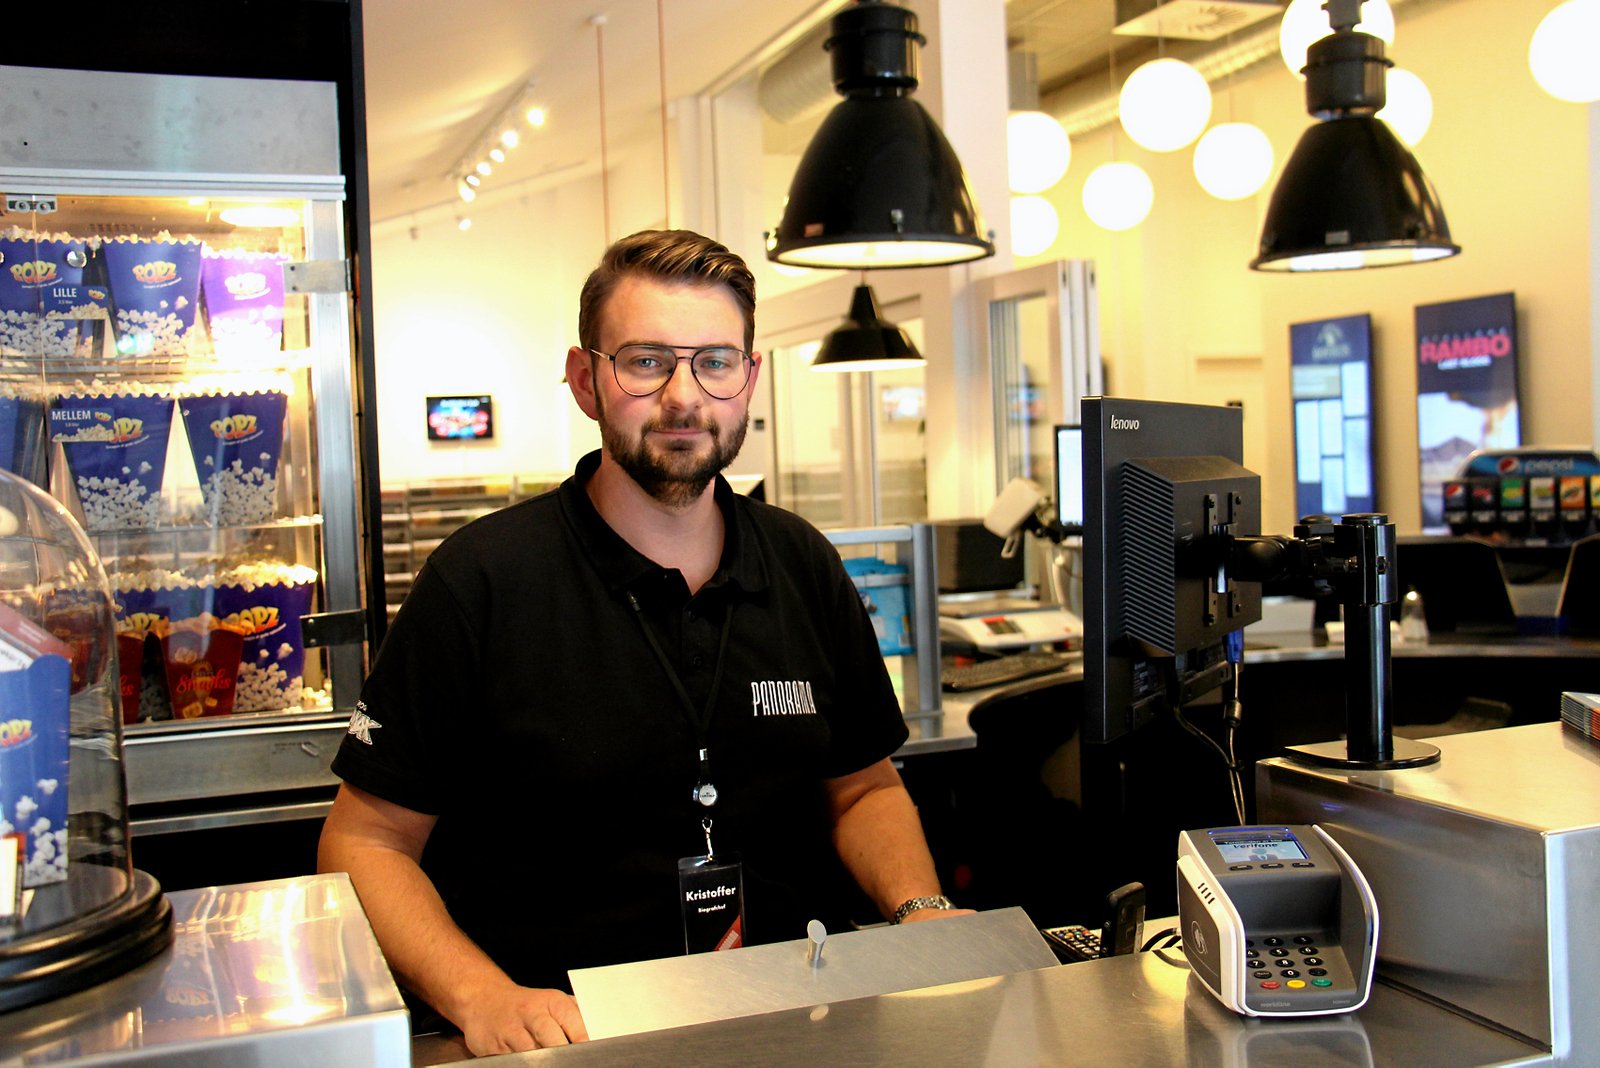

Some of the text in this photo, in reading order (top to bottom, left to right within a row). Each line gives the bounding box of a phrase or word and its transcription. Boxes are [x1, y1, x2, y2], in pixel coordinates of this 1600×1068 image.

[53, 288, 77, 298] LILLE
[1420, 333, 1511, 364] RAMBO
[52, 410, 91, 420] MELLEM
[1110, 414, 1140, 430] lenovo
[209, 414, 257, 440] POPZ
[750, 680, 817, 717] PANORAMA
[0, 719, 32, 747] OPZ
[685, 885, 736, 902] Kristoffer
